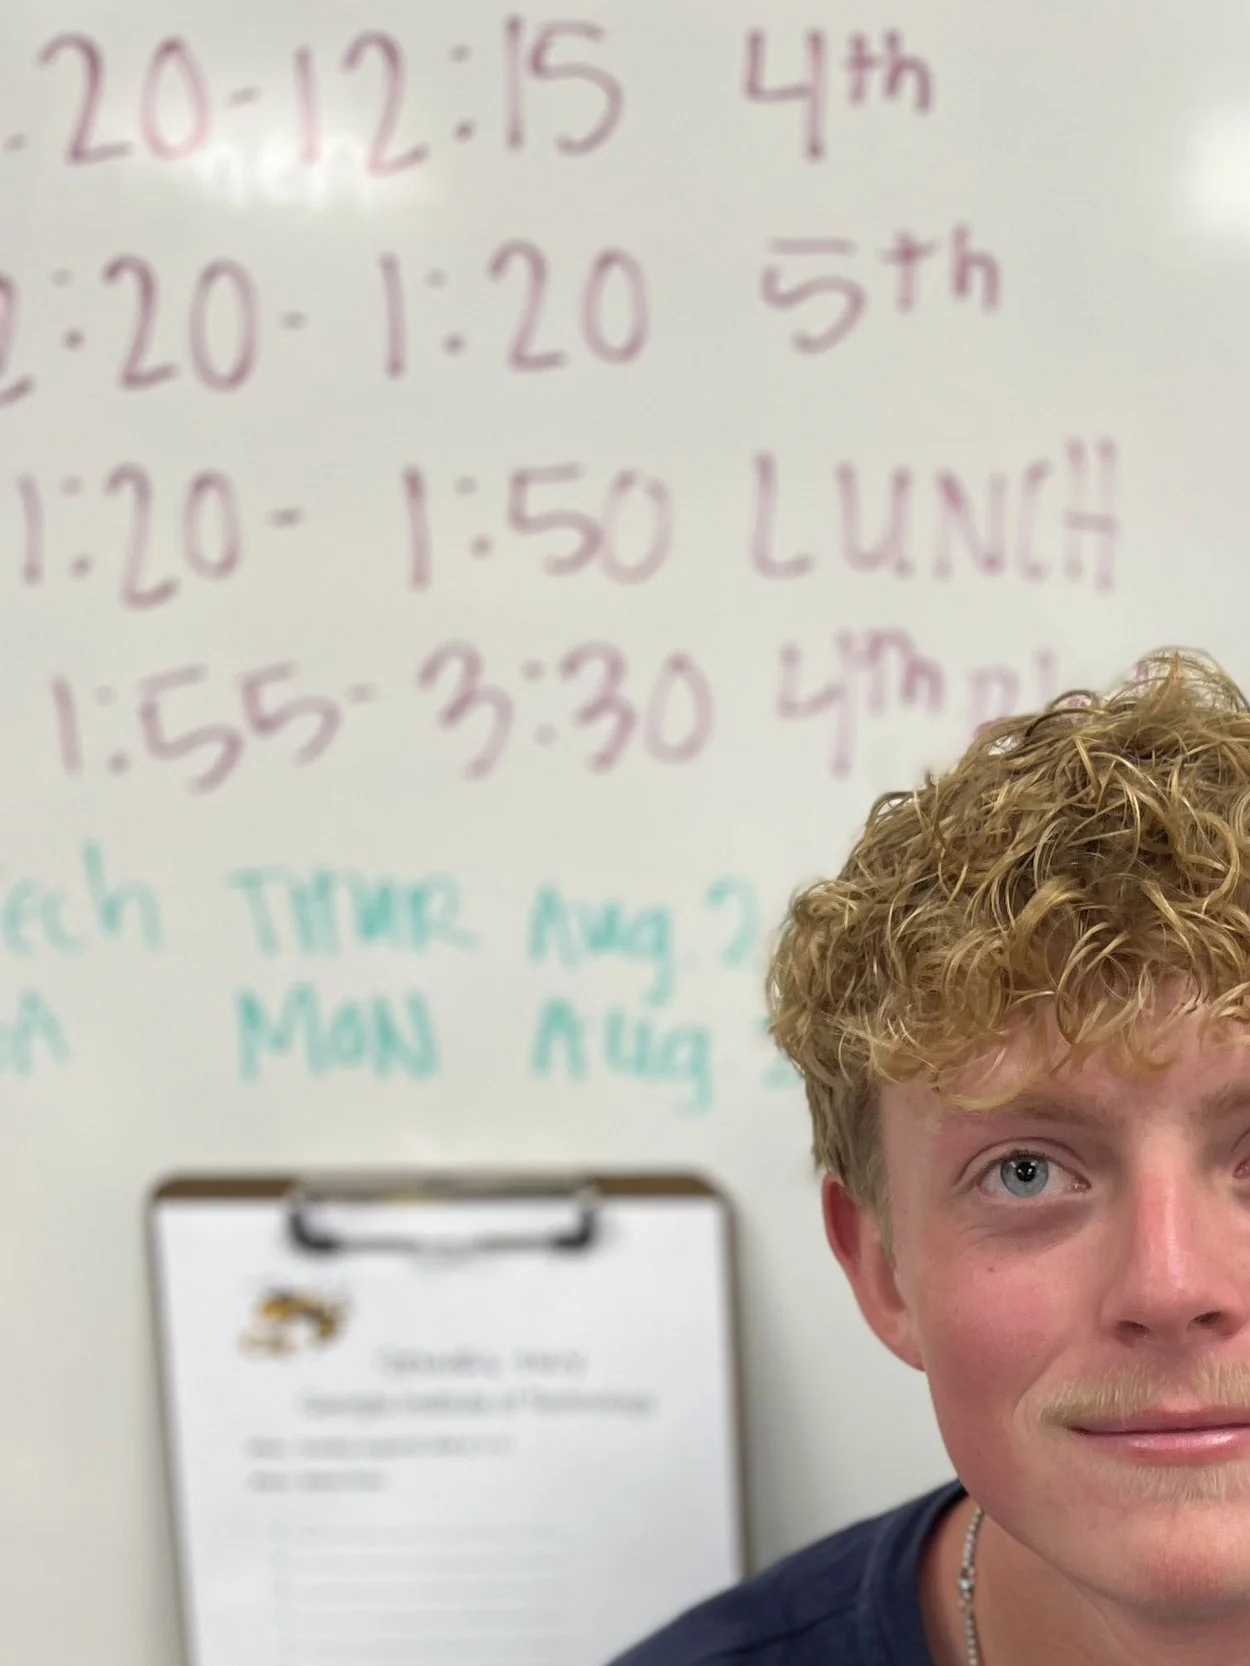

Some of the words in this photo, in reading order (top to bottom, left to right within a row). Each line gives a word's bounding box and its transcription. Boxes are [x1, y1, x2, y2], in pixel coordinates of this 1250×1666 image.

[741, 27, 936, 164] 4th
[379, 239, 649, 381] 1:20
[759, 222, 1002, 355] 5th
[400, 463, 672, 591] 1:50
[748, 436, 1119, 592] LUNCH
[416, 641, 713, 780] 3:30
